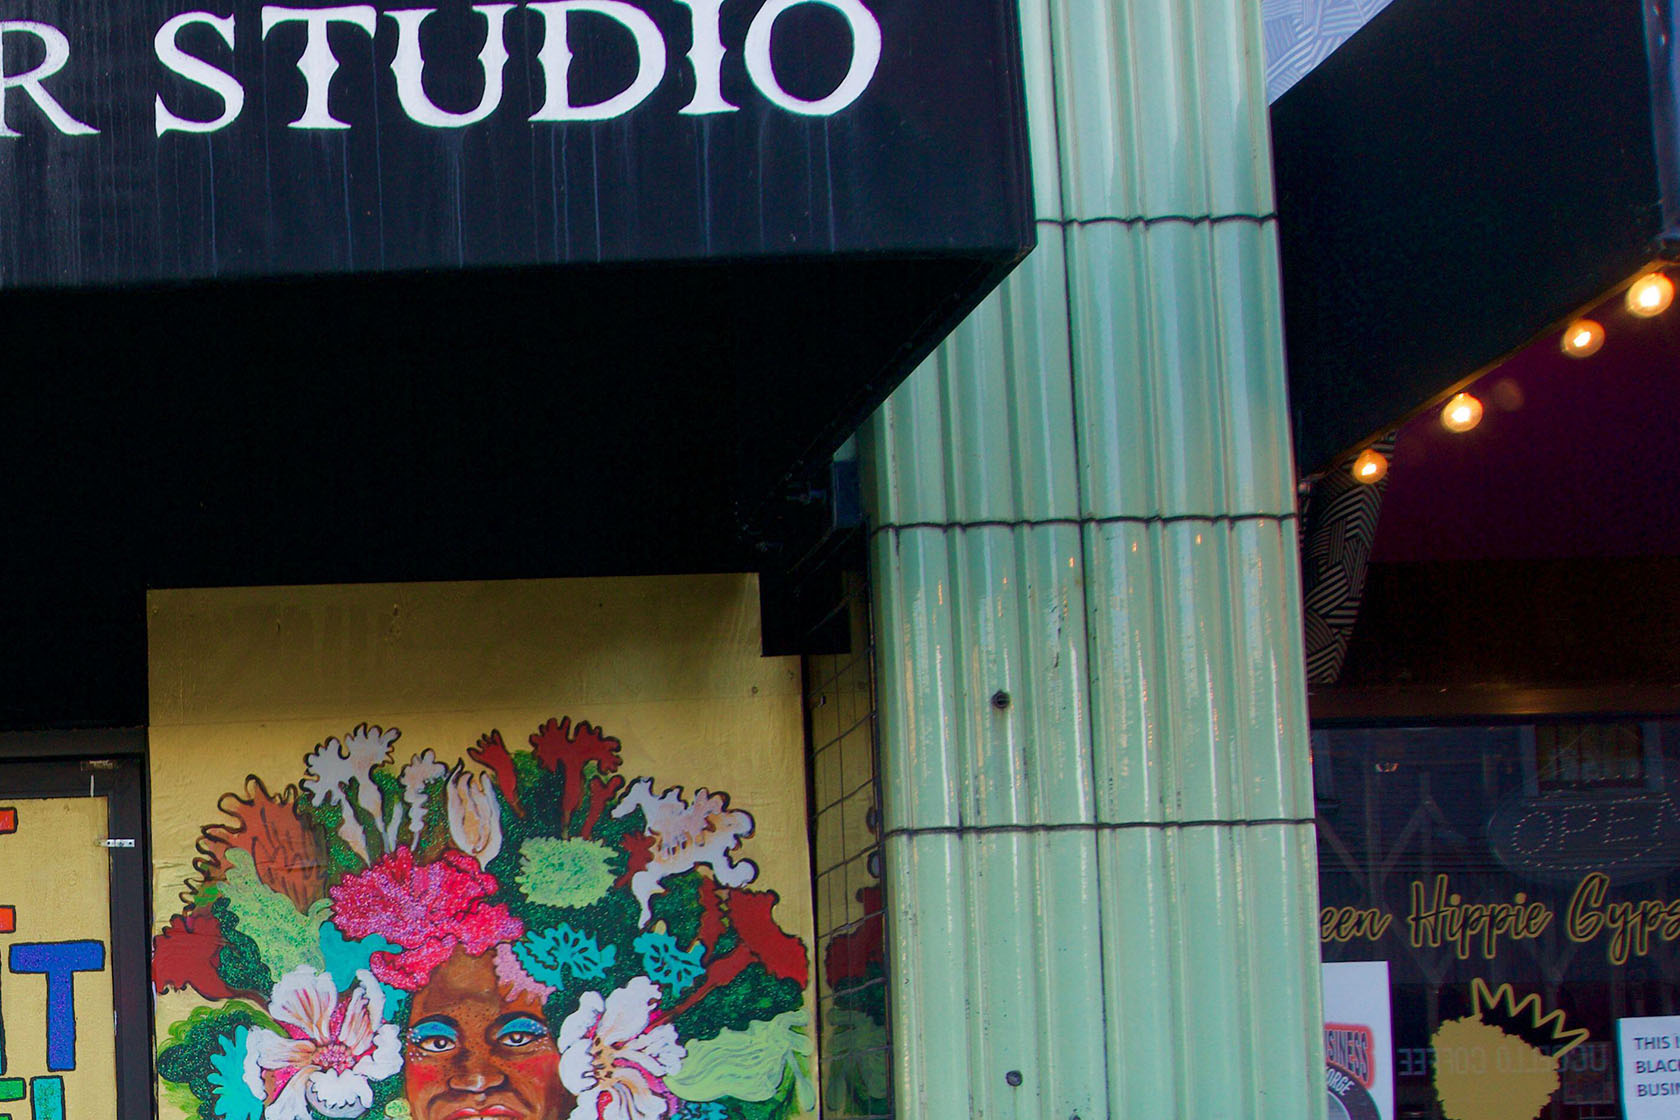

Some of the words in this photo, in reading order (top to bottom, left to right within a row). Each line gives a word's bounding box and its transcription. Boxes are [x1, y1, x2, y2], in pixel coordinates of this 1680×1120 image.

[153, 0, 883, 138] STUDIO
[1410, 873, 1553, 960] Hippie
[1324, 1030, 1368, 1083] SINESS
[1633, 1036, 1672, 1050] THIS
[1636, 1059, 1680, 1074] BLAC
